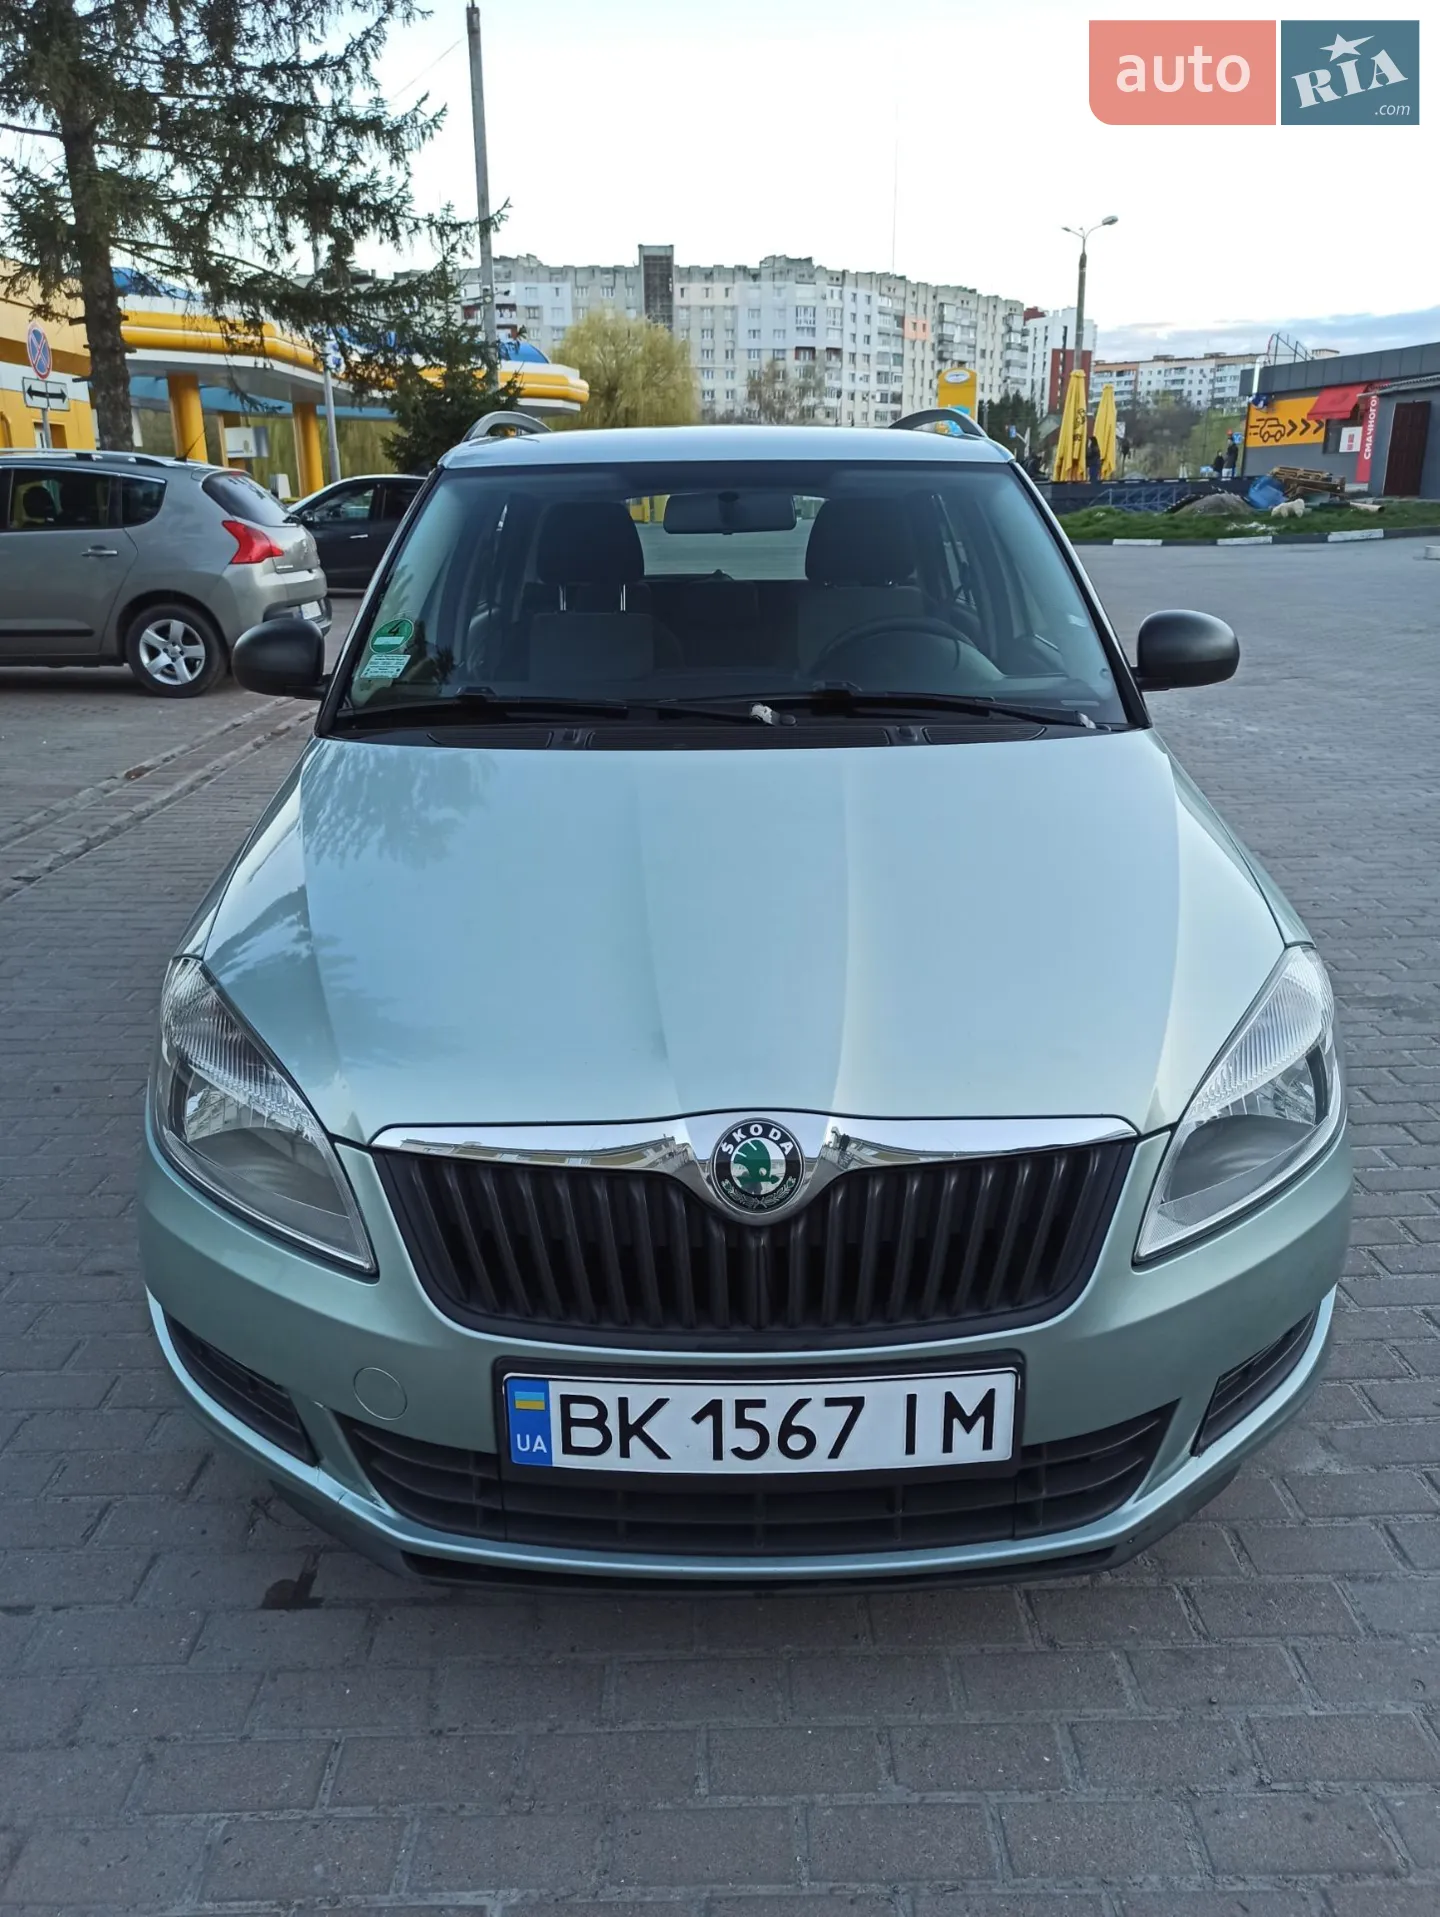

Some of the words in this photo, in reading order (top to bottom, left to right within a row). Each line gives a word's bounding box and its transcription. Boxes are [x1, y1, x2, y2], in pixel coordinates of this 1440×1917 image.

[516, 1433, 547, 1453] UA
[559, 1393, 672, 1461] BK
[690, 1395, 866, 1462] 1567
[904, 1387, 996, 1456] IM
